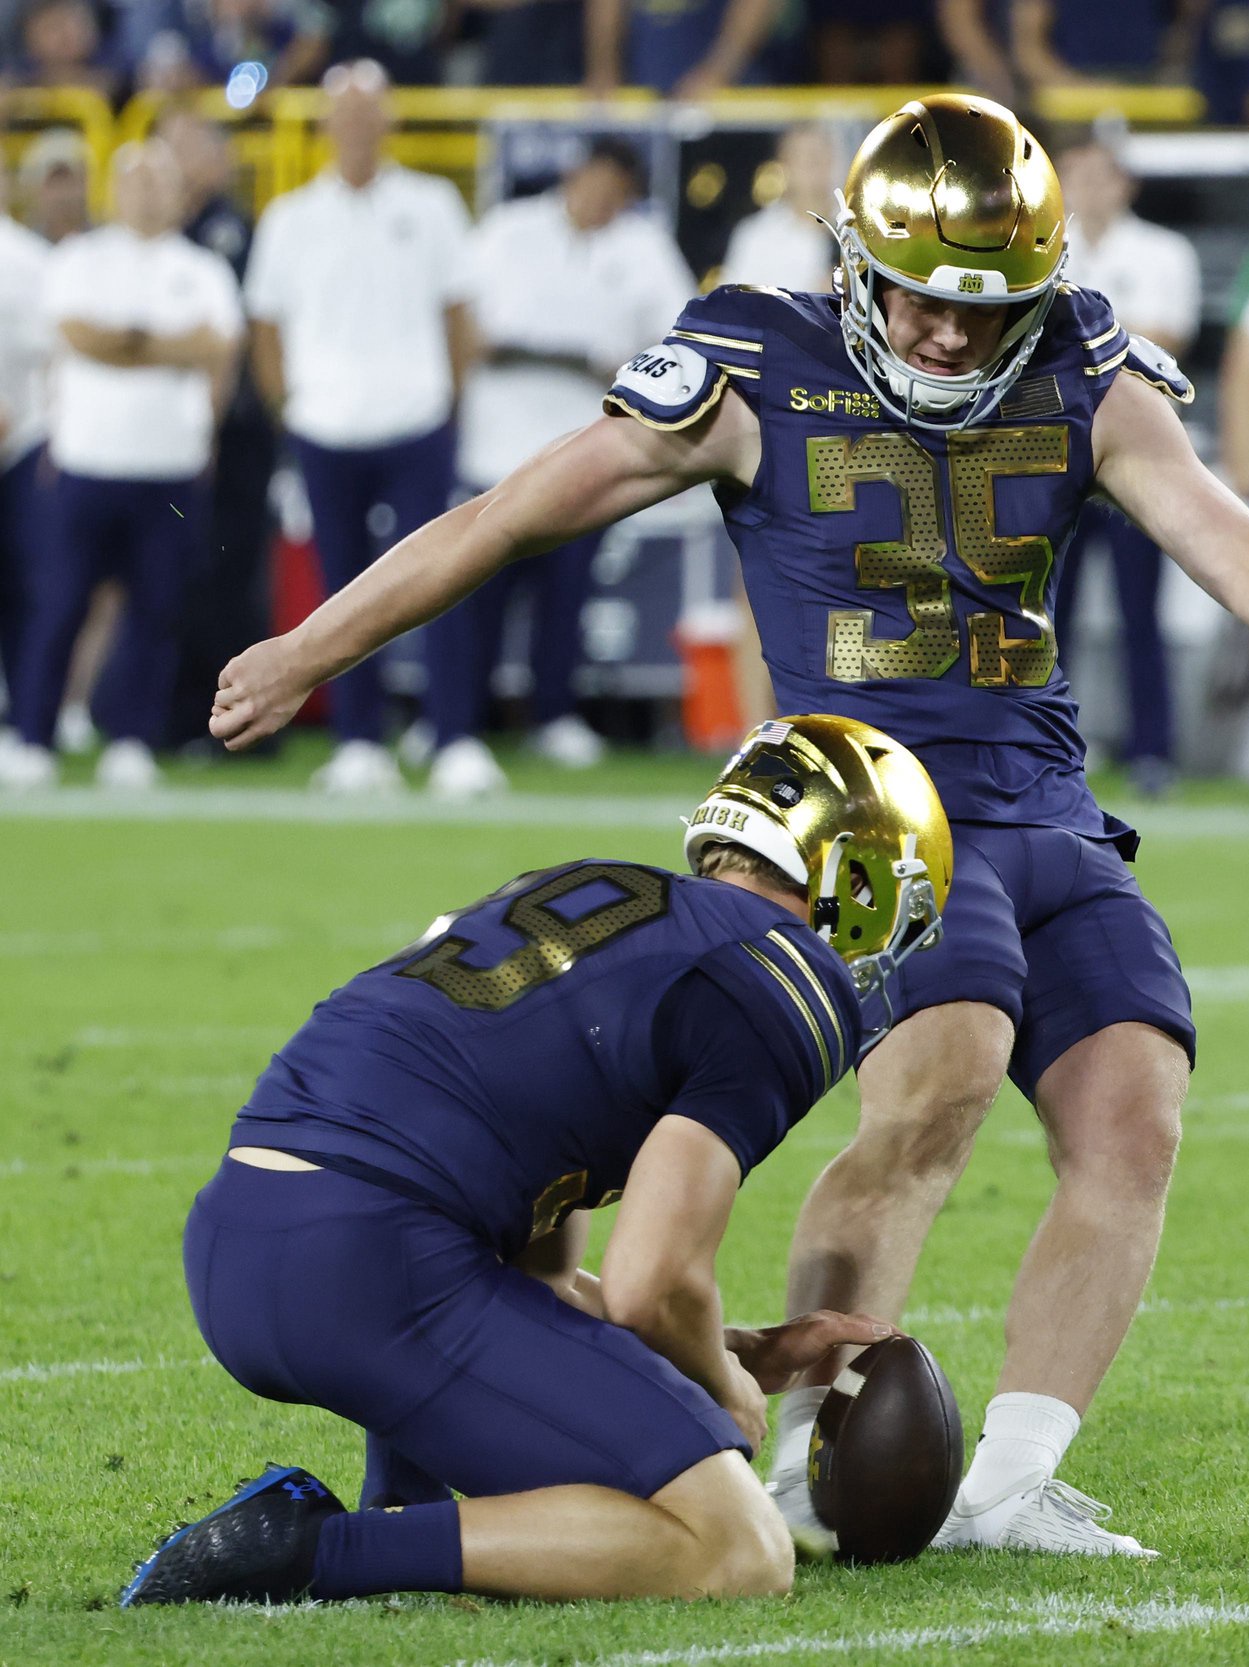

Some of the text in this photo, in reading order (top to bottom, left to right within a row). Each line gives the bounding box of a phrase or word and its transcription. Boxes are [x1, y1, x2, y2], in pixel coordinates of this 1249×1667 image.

[789, 387, 852, 414] SoFi
[806, 425, 1069, 687] 35
[688, 805, 749, 832] IRISH
[384, 862, 671, 1012] 9
